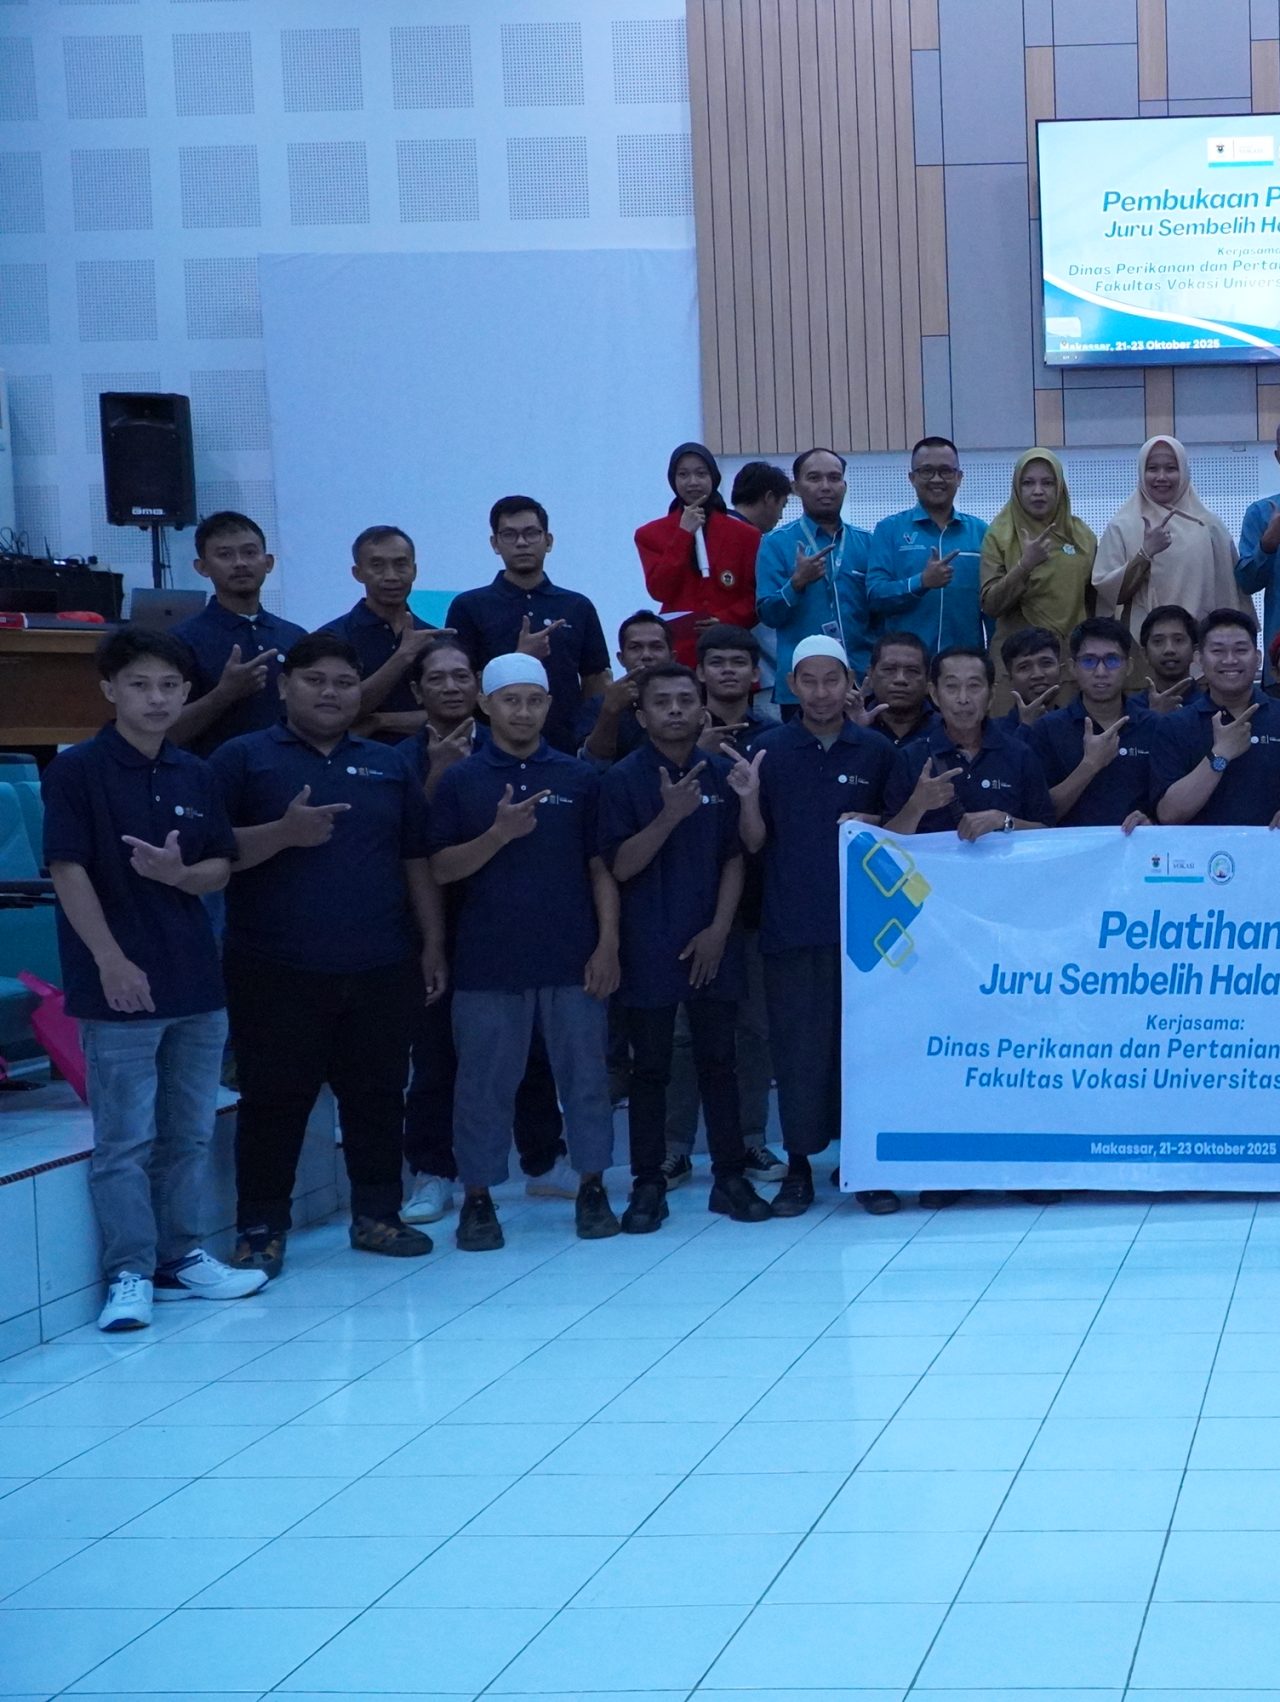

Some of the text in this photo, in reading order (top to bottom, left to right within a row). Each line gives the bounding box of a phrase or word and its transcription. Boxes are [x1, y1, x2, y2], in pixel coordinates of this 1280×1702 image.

[1103, 188, 1259, 213] Pembukaan
[1104, 221, 1153, 238] Juru
[1158, 216, 1256, 237] Sembelih
[1068, 264, 1112, 277] Dinas
[1116, 262, 1195, 275] Perikanan
[1199, 260, 1228, 273] dan
[1095, 280, 1161, 292] Fakultas
[1167, 279, 1218, 290] Vokasi
[1146, 340, 1191, 350] Oktober
[1192, 338, 1220, 349] 2025
[979, 964, 1053, 995] Juru
[1059, 962, 1203, 995] Sembelih
[1146, 1014, 1245, 1034] Kerjasama:
[927, 1036, 990, 1057] Dinas
[998, 1038, 1112, 1059] Perikanan
[1120, 1038, 1160, 1059] dan
[1167, 1038, 1280, 1059] Pertanian
[965, 1067, 1063, 1088] Fakultas
[1072, 1068, 1147, 1089] Vokasi
[1091, 1142, 1277, 1157] Makassar, 21-23 Oktober 2025
